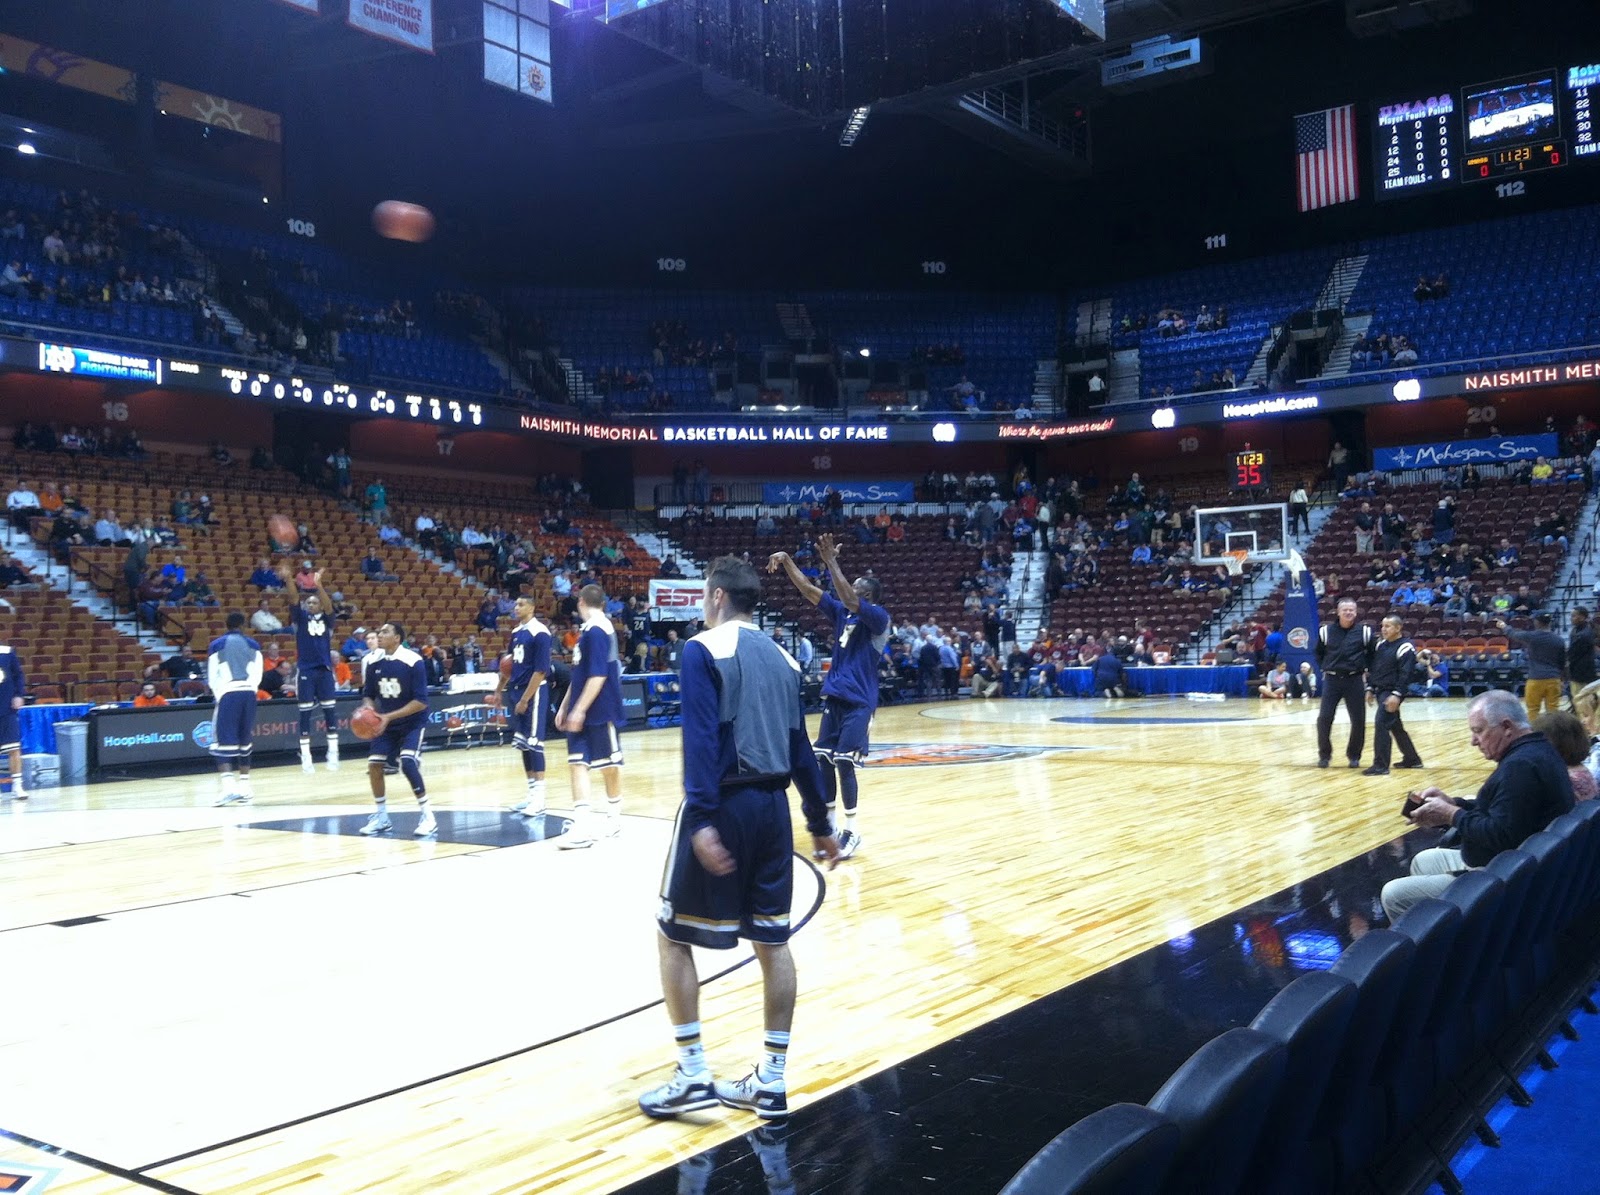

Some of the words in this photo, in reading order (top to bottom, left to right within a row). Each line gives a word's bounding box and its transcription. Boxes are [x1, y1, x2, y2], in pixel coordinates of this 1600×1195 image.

[363, 3, 420, 35] CHAMPIONS
[1576, 88, 1588, 97] 11
[1576, 99, 1590, 109] 22
[1379, 115, 1403, 126] Player
[1406, 110, 1426, 121] Fouls
[1428, 105, 1453, 117] Points
[1576, 110, 1590, 120] 24
[1392, 125, 1397, 133] 1
[1415, 121, 1422, 129] 0
[1439, 116, 1446, 124] 0
[1392, 136, 1399, 144] 2
[1415, 131, 1422, 139] 0
[1439, 126, 1447, 135] 0
[1388, 146, 1399, 156] 12
[1416, 141, 1423, 150] 0
[1440, 137, 1447, 145] 0
[1575, 143, 1596, 155] TEAM
[1387, 157, 1399, 167] 24
[1416, 152, 1424, 161] 0
[1440, 147, 1448, 156] 0
[1551, 152, 1559, 164] 0
[1388, 168, 1400, 177] 25
[1417, 163, 1424, 171] 0
[1441, 158, 1448, 167] 0
[1481, 164, 1488, 177] 0
[1384, 178, 1403, 189] TEAM
[1404, 173, 1426, 186] FOULS
[1442, 168, 1450, 179] 0
[1495, 181, 1525, 198] 112
[286, 218, 316, 237] 108
[1204, 233, 1226, 250] 111
[656, 257, 686, 272] 109
[921, 260, 946, 274] 110
[80, 361, 128, 376] FIGHTING
[130, 368, 155, 380] IRISH
[1465, 369, 1557, 390] NAISMITH
[230, 379, 241, 394] 0
[251, 380, 262, 396] 0
[274, 383, 285, 399] 0
[102, 401, 129, 421] 16
[1223, 396, 1318, 418] HoopHall.com
[1466, 406, 1497, 424] 20
[520, 415, 580, 436] NAISMITH
[583, 424, 658, 440] MEMORIAL
[663, 427, 768, 441] BASKETBALL
[772, 427, 814, 440] HALL
[819, 427, 841, 440] OF
[846, 427, 888, 440] FAME
[998, 425, 1028, 437] Where
[1027, 425, 1041, 438] the
[1040, 427, 1066, 440] game
[1066, 423, 1090, 434] never
[1090, 418, 1115, 432] ends!
[436, 440, 455, 456] 17
[1178, 437, 1200, 452] 19
[1415, 443, 1496, 465] Mohegan
[1499, 441, 1539, 458] Sun
[811, 455, 832, 470] 18
[1237, 464, 1261, 486] 35
[867, 485, 899, 501] Sun
[656, 588, 705, 607] ESP
[633, 619, 646, 631] 24
[103, 732, 184, 748] HoopHall.com
